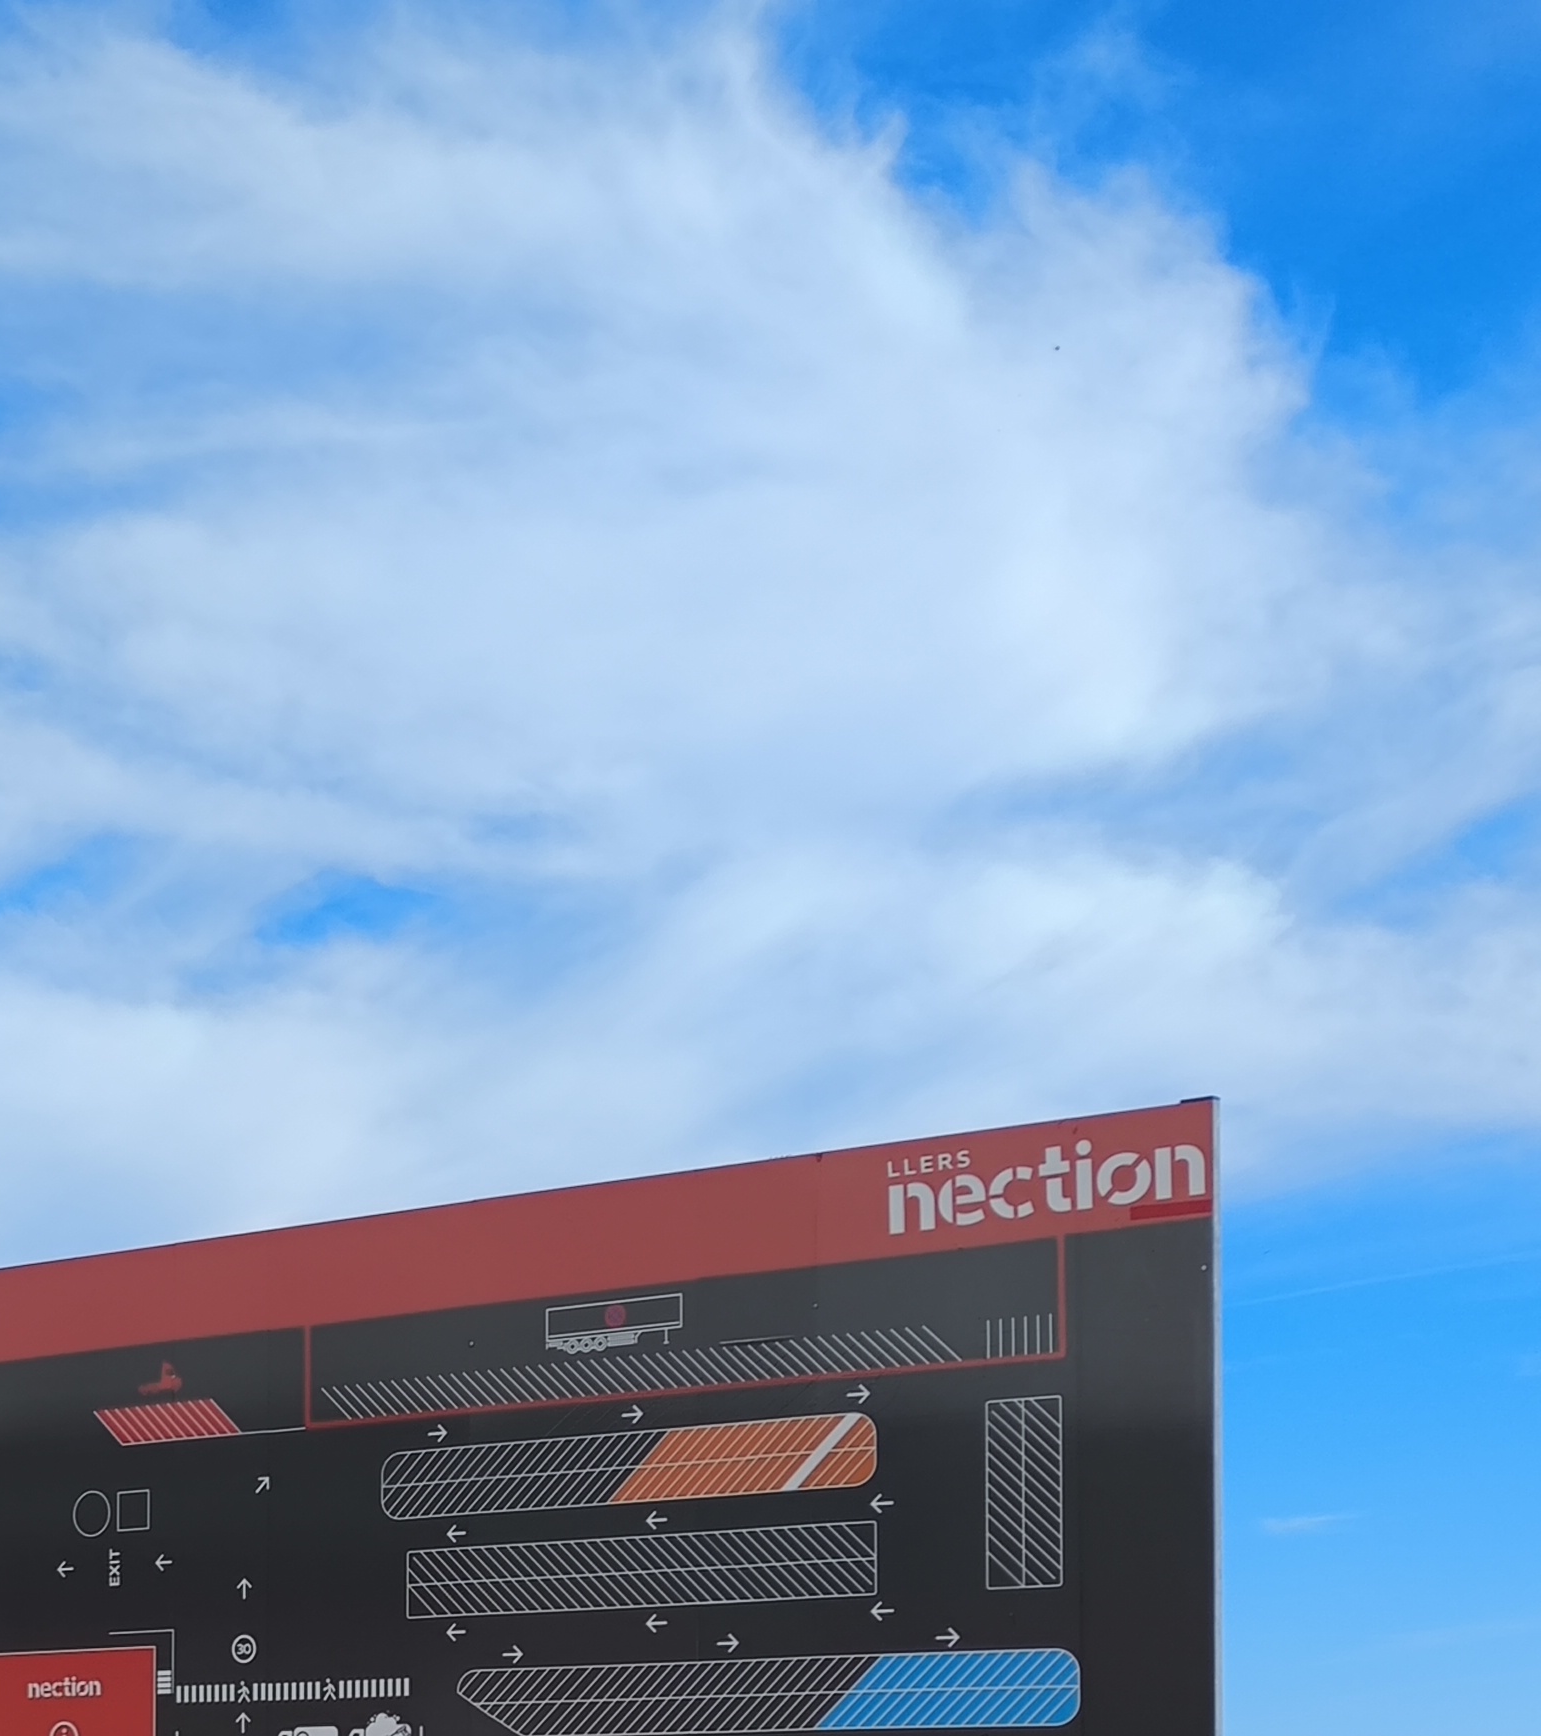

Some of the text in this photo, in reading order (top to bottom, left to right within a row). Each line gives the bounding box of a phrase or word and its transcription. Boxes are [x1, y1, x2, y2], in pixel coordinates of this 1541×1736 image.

[887, 1149, 972, 1179] LLERS
[888, 1139, 1206, 1236] nection
[108, 1549, 121, 1587] EXIT
[236, 1643, 252, 1655] 30
[26, 1677, 102, 1699] nection
